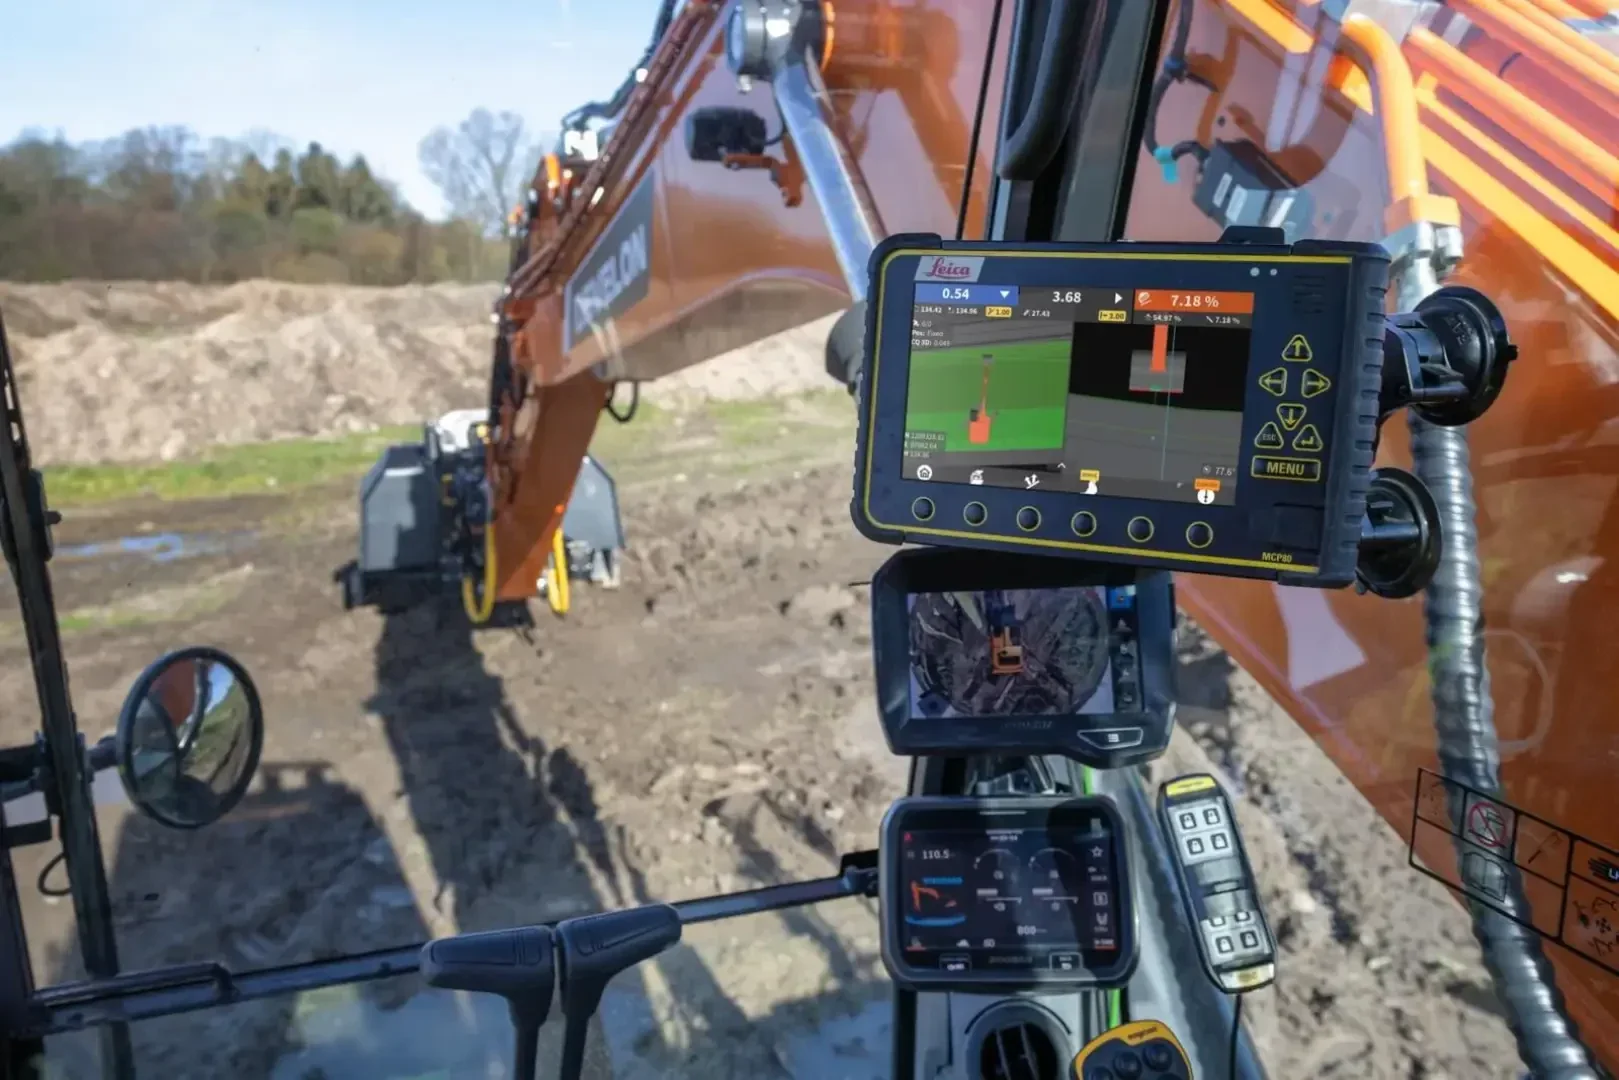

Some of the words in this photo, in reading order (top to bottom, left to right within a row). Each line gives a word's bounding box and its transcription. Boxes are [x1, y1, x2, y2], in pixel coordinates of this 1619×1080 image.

[925, 256, 972, 280] Leica
[942, 287, 970, 300] 0.54
[1052, 291, 1082, 303] 3.68
[1171, 294, 1201, 307] 7.18
[1205, 296, 1219, 308] %
[1266, 461, 1305, 476] MENU
[1261, 551, 1293, 564] MCP80
[922, 848, 950, 860] 110.5
